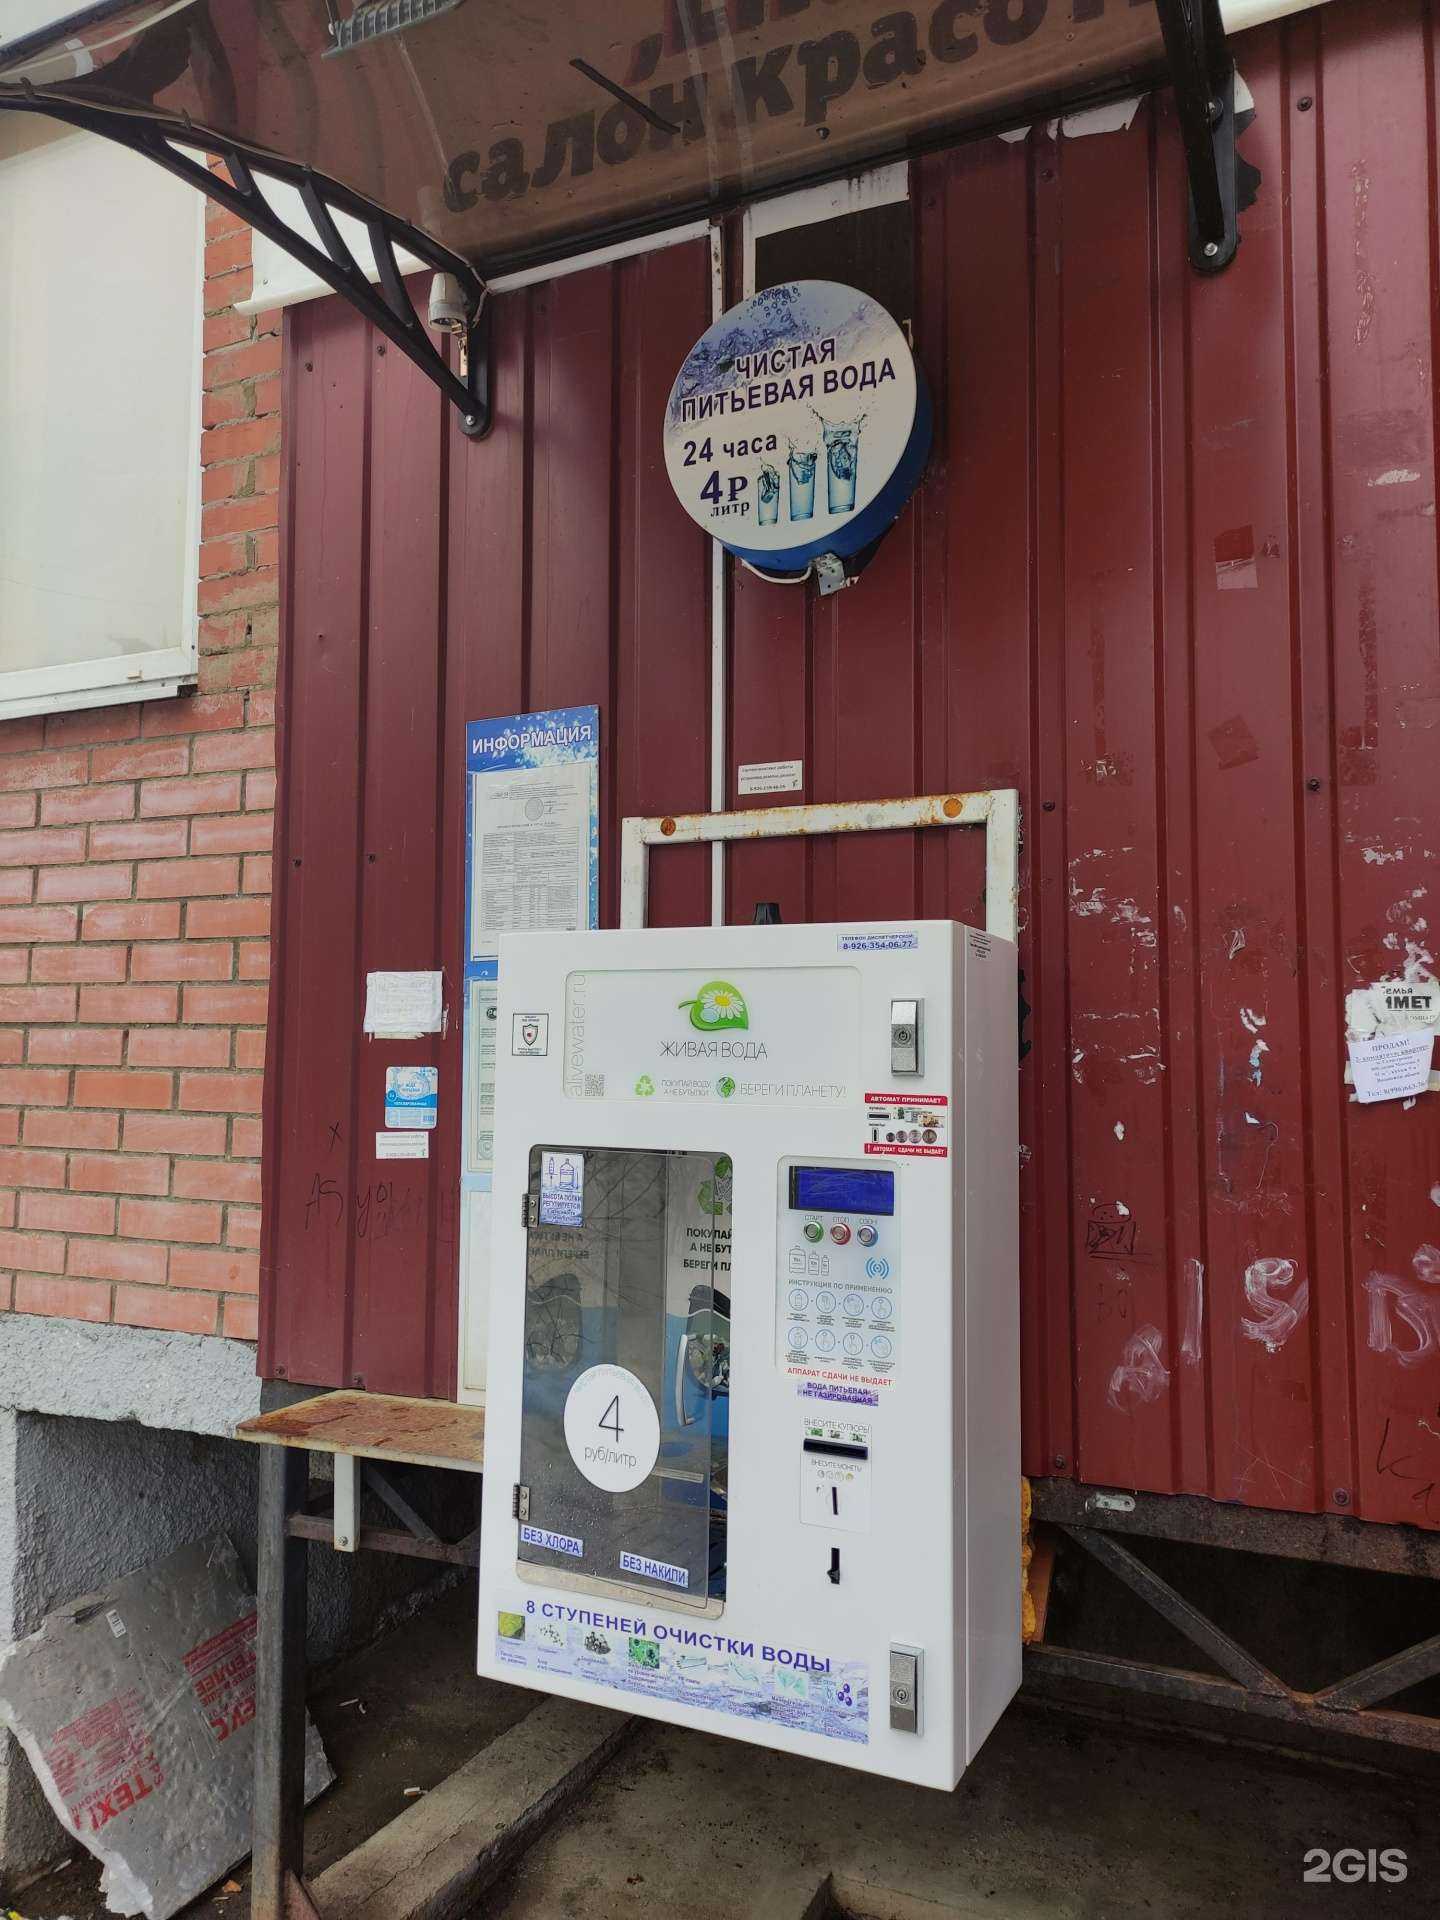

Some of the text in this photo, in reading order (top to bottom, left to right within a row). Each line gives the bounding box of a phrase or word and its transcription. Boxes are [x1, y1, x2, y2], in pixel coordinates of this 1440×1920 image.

[444, 76, 707, 213] салон
[730, 0, 1156, 126] красо
[735, 337, 837, 379] ЧИСТАЯ
[681, 357, 896, 422] ПИТЬЕВАЯ ВОДА
[683, 434, 778, 467] 24 часа
[710, 501, 750, 517] литр
[472, 725, 592, 754] ИНФОРМАЦИЯ
[843, 941, 913, 950] 8-926-354-06-77
[1381, 986, 1413, 994] емья
[568, 974, 586, 1097] alivewater.ru
[659, 1041, 768, 1061] ЖИВАЯ ВОДА
[740, 1083, 847, 1098] БЕРЕГИ ПЛАНЕТУ!
[700, 1243, 712, 1253] НЕ
[787, 1367, 820, 1377] АППАРАТ
[821, 1371, 848, 1380] СДАЧИ
[860, 1377, 893, 1386] ВЫДАЕТ
[807, 1382, 827, 1390] ВОДА
[598, 1395, 625, 1443] 4
[584, 1446, 637, 1470] руб/литр
[523, 1527, 580, 1554] БЕЗ ХЛОРА
[623, 1554, 687, 1585] БЕЗ НАКИПИ
[526, 1600, 830, 1673] 8 СТУПЕНЕЙ ОЧИСТКИ ВОДЫ
